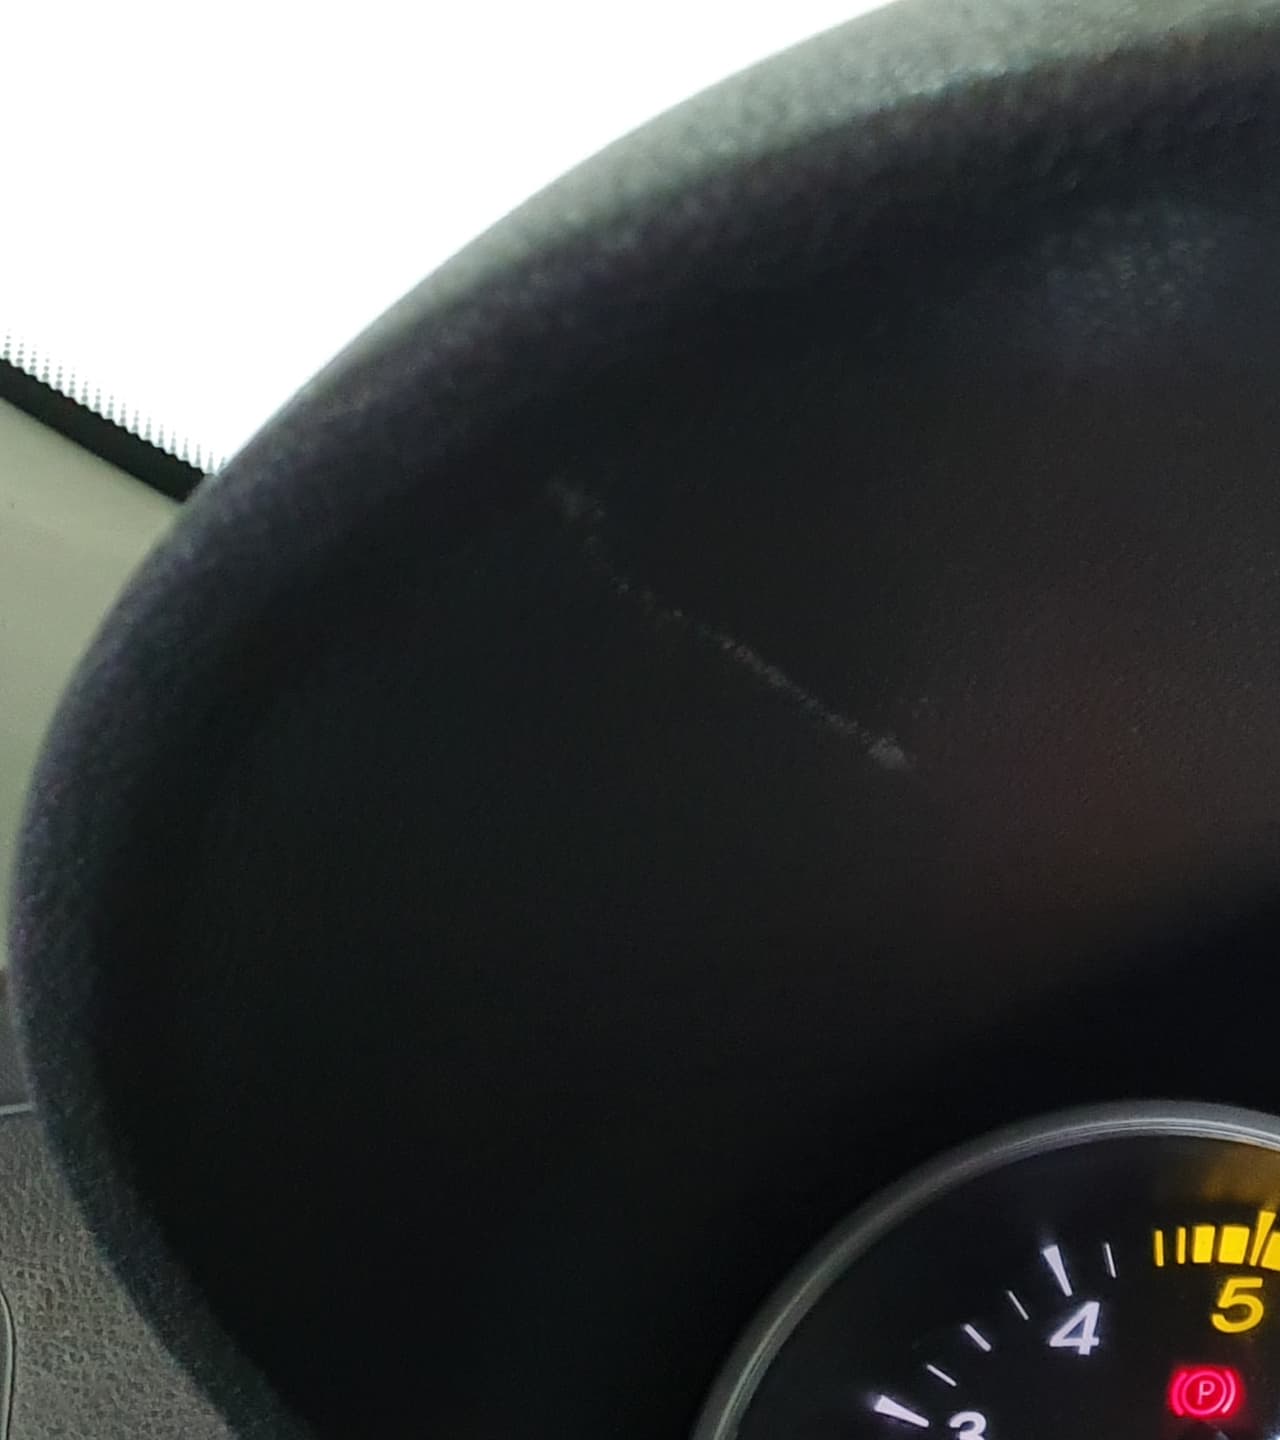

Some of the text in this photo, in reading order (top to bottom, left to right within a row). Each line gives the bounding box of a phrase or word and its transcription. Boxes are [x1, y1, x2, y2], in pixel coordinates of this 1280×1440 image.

[1049, 1301, 1100, 1356] 4
[1210, 1277, 1264, 1333] 5
[1199, 1381, 1216, 1403] P
